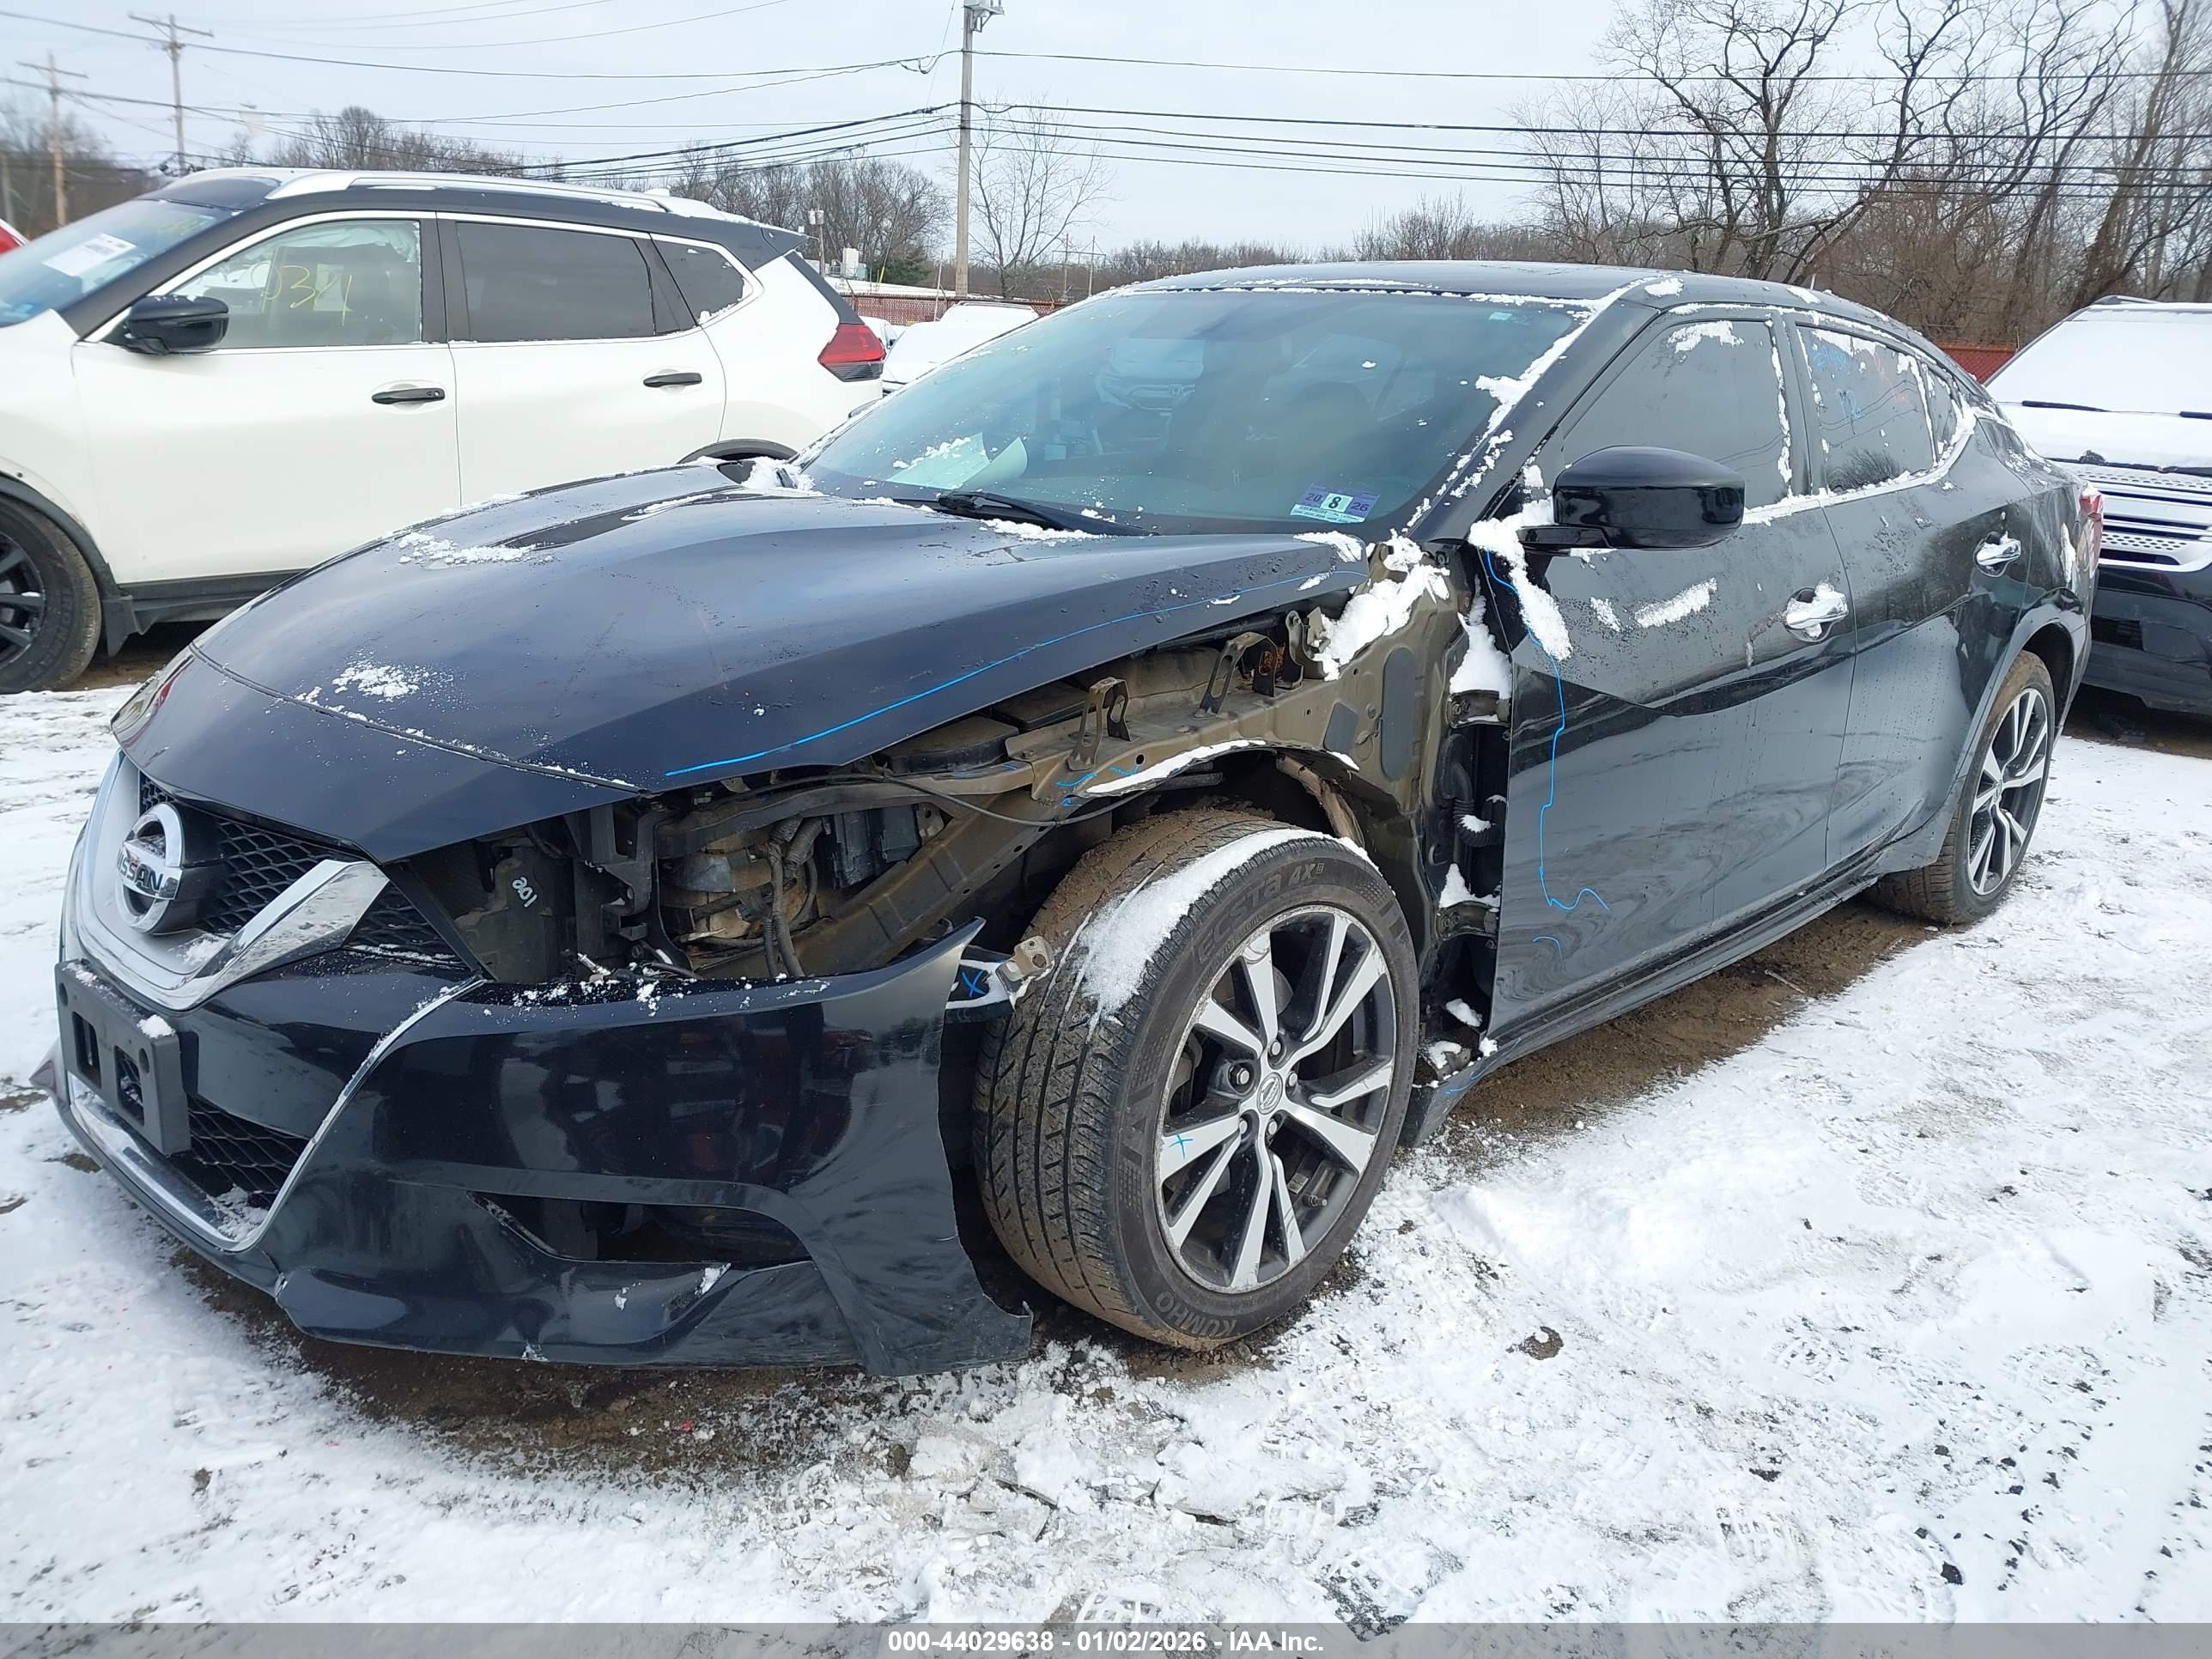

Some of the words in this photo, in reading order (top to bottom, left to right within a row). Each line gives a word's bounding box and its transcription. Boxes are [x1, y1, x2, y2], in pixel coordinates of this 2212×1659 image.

[1304, 493, 1323, 502] 20
[1328, 496, 1342, 508] 8
[1350, 501, 1370, 512] 26
[1155, 1291, 1237, 1338] KUMHO
